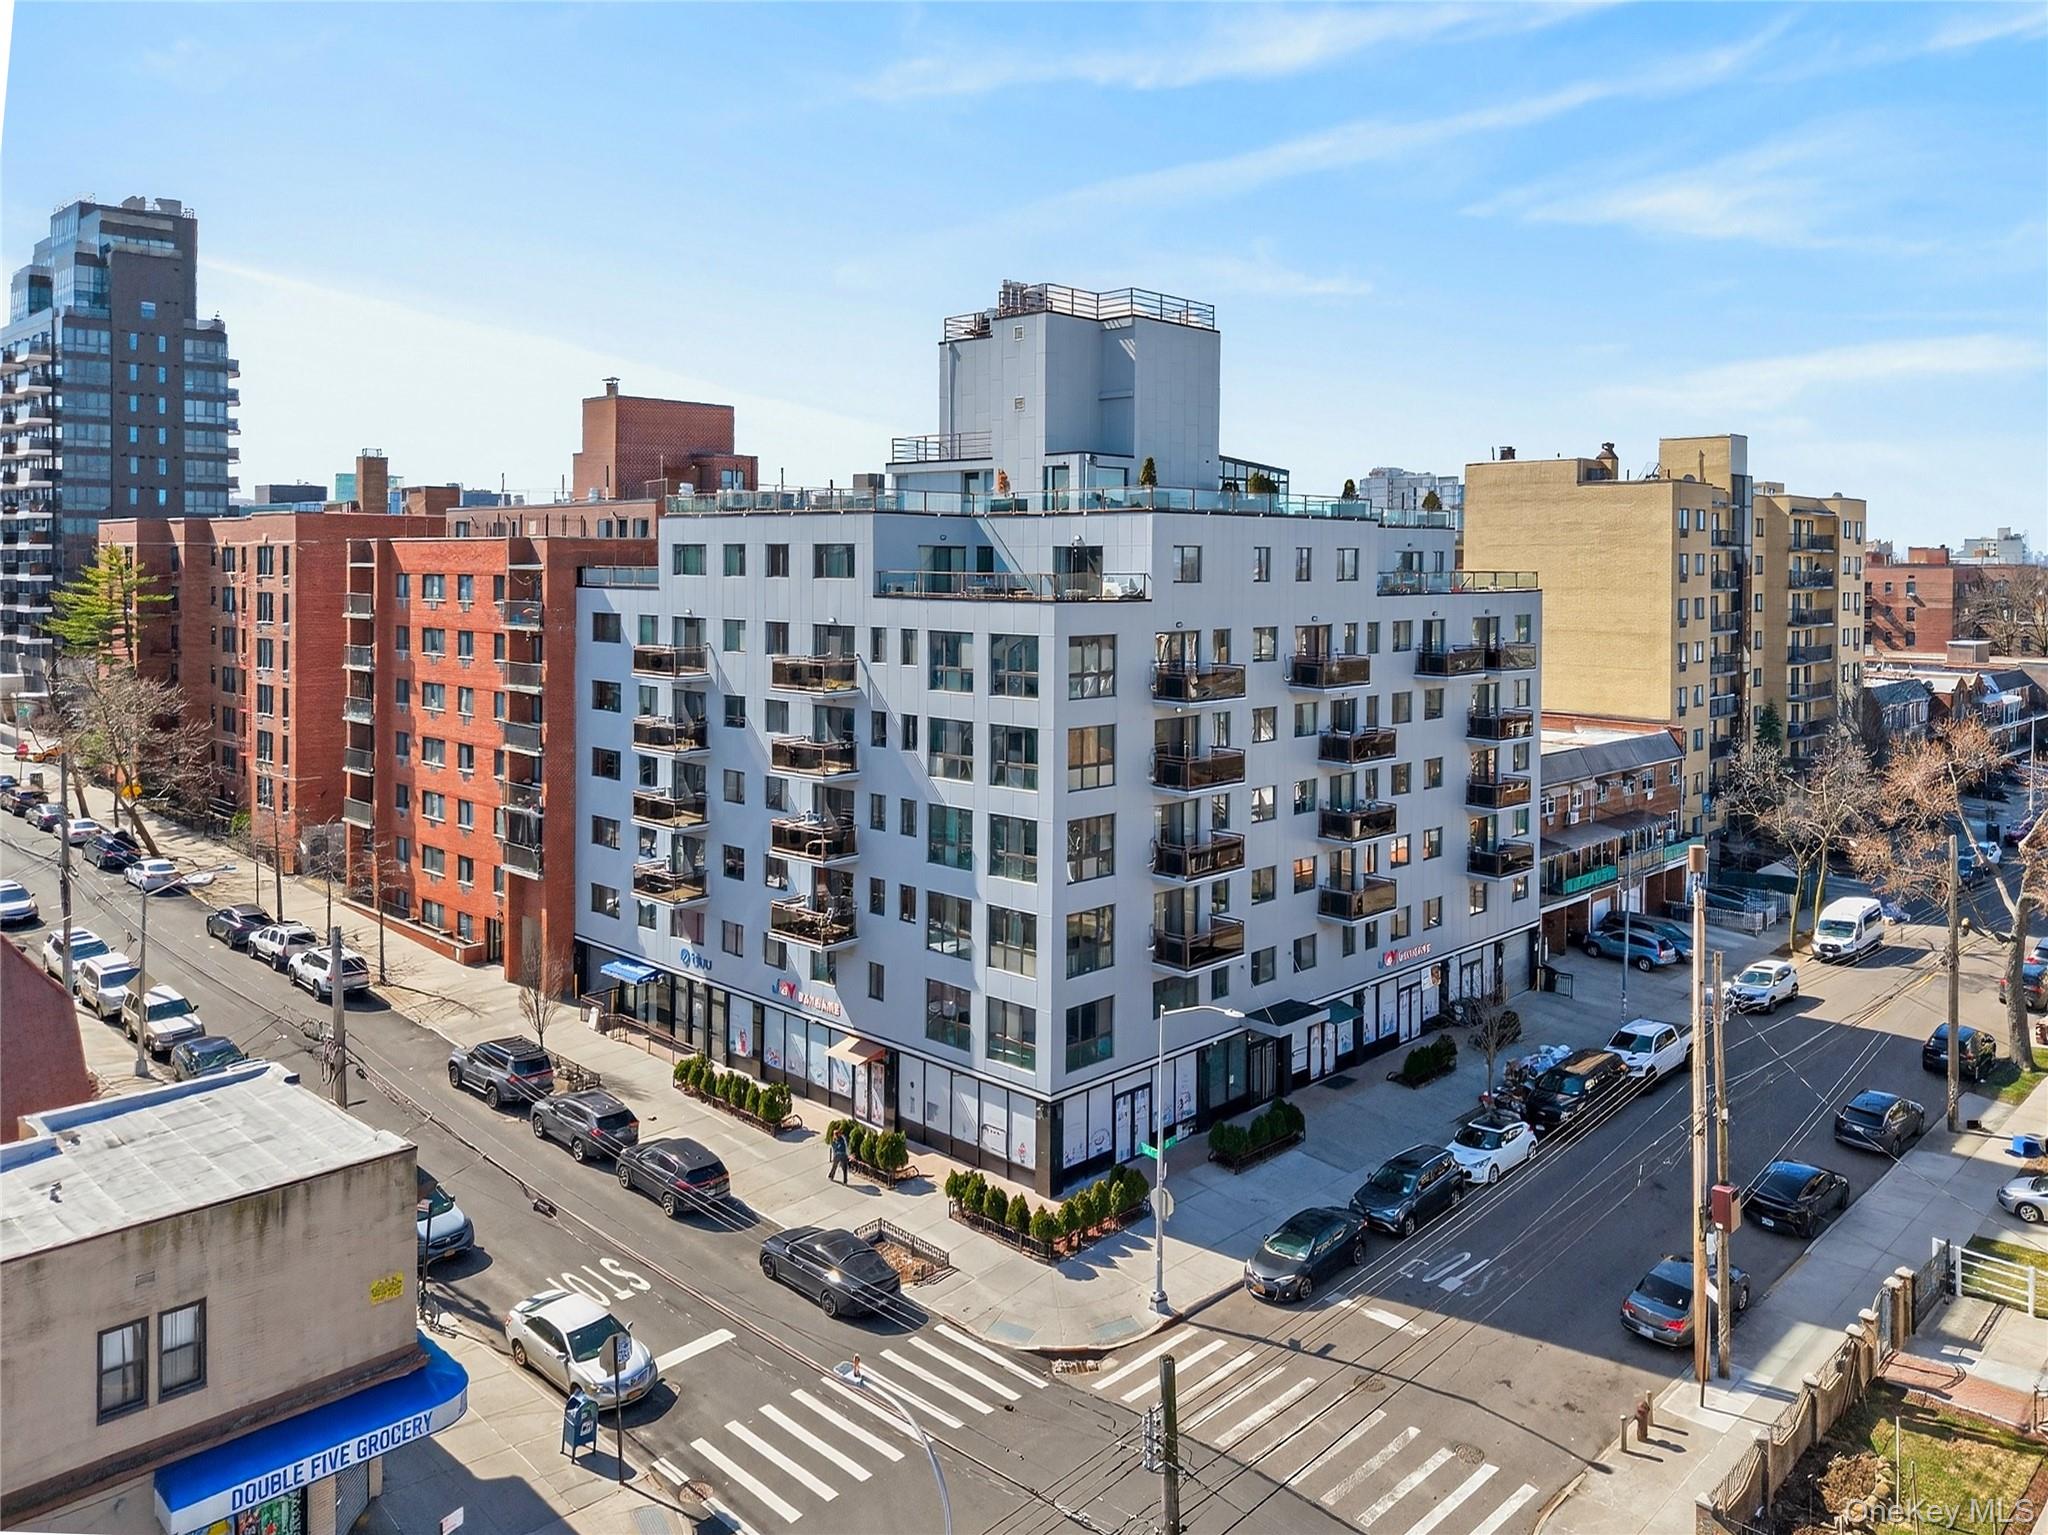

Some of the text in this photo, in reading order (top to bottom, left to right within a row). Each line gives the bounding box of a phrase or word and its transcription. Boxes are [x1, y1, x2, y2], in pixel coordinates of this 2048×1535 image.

[545, 1258, 651, 1306] STO
[232, 1412, 433, 1511] DOUBLE FIVE GROCERY
